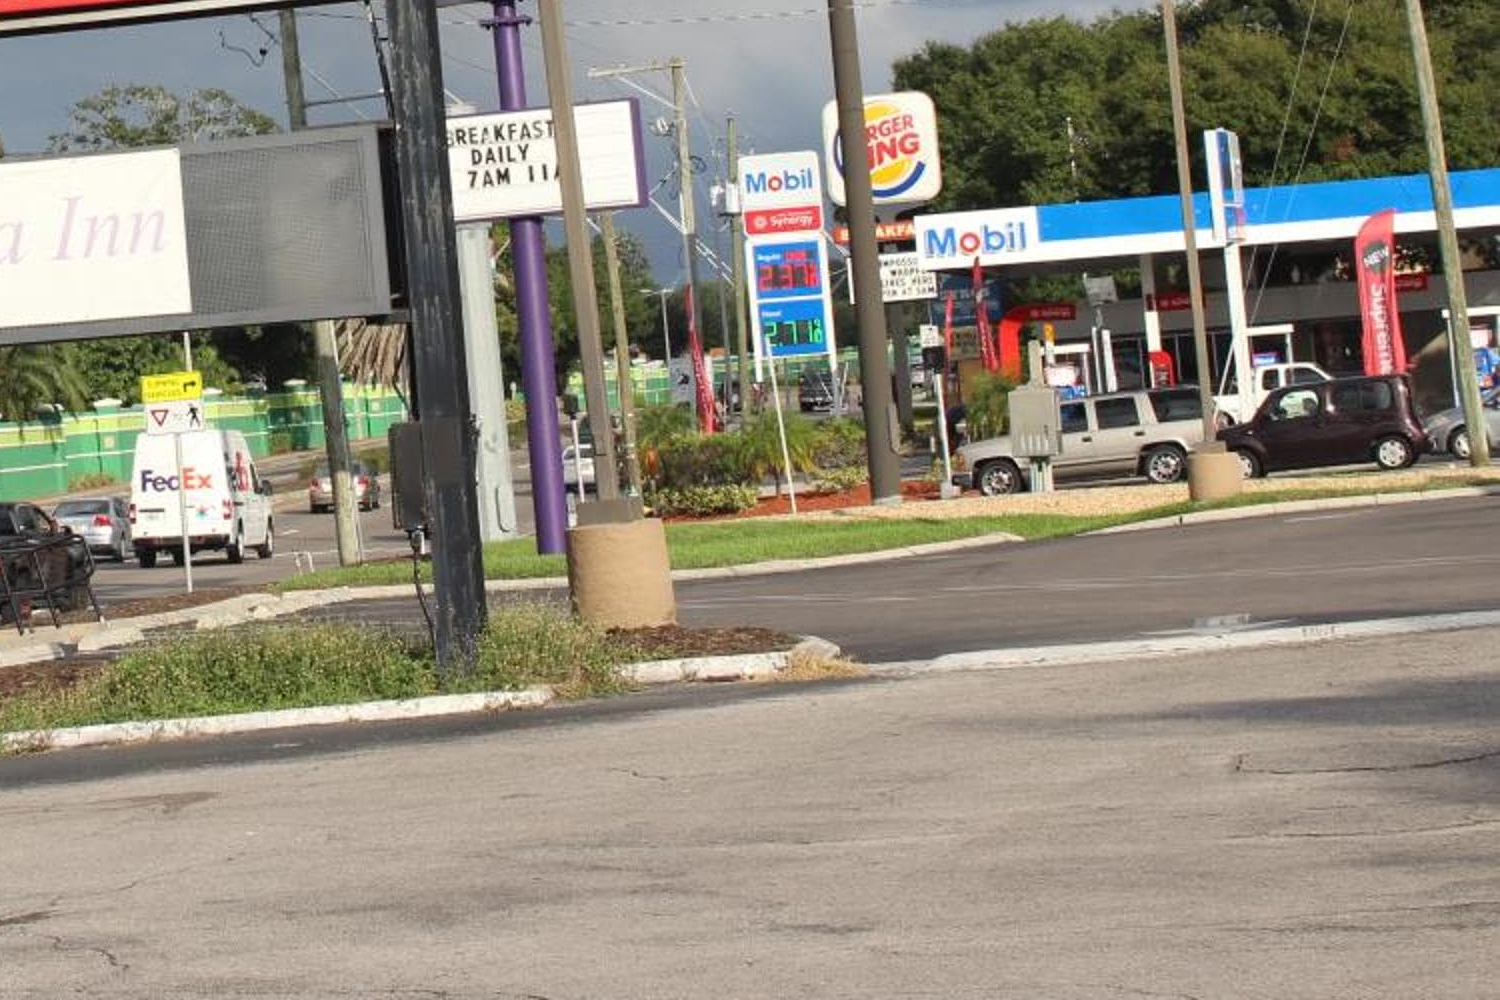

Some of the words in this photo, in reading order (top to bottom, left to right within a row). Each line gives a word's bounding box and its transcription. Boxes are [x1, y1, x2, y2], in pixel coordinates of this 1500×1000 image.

[445, 119, 555, 149] BREAKFAST
[866, 113, 914, 142] RGER
[471, 143, 529, 166] DAILY
[467, 167, 511, 188] 7AM
[745, 168, 814, 193] Mobil
[51, 194, 167, 262] Inn
[770, 215, 814, 229] Synergy
[925, 222, 1027, 256] Mobil
[1364, 245, 1390, 269] NEW
[141, 467, 213, 492] FedEx
